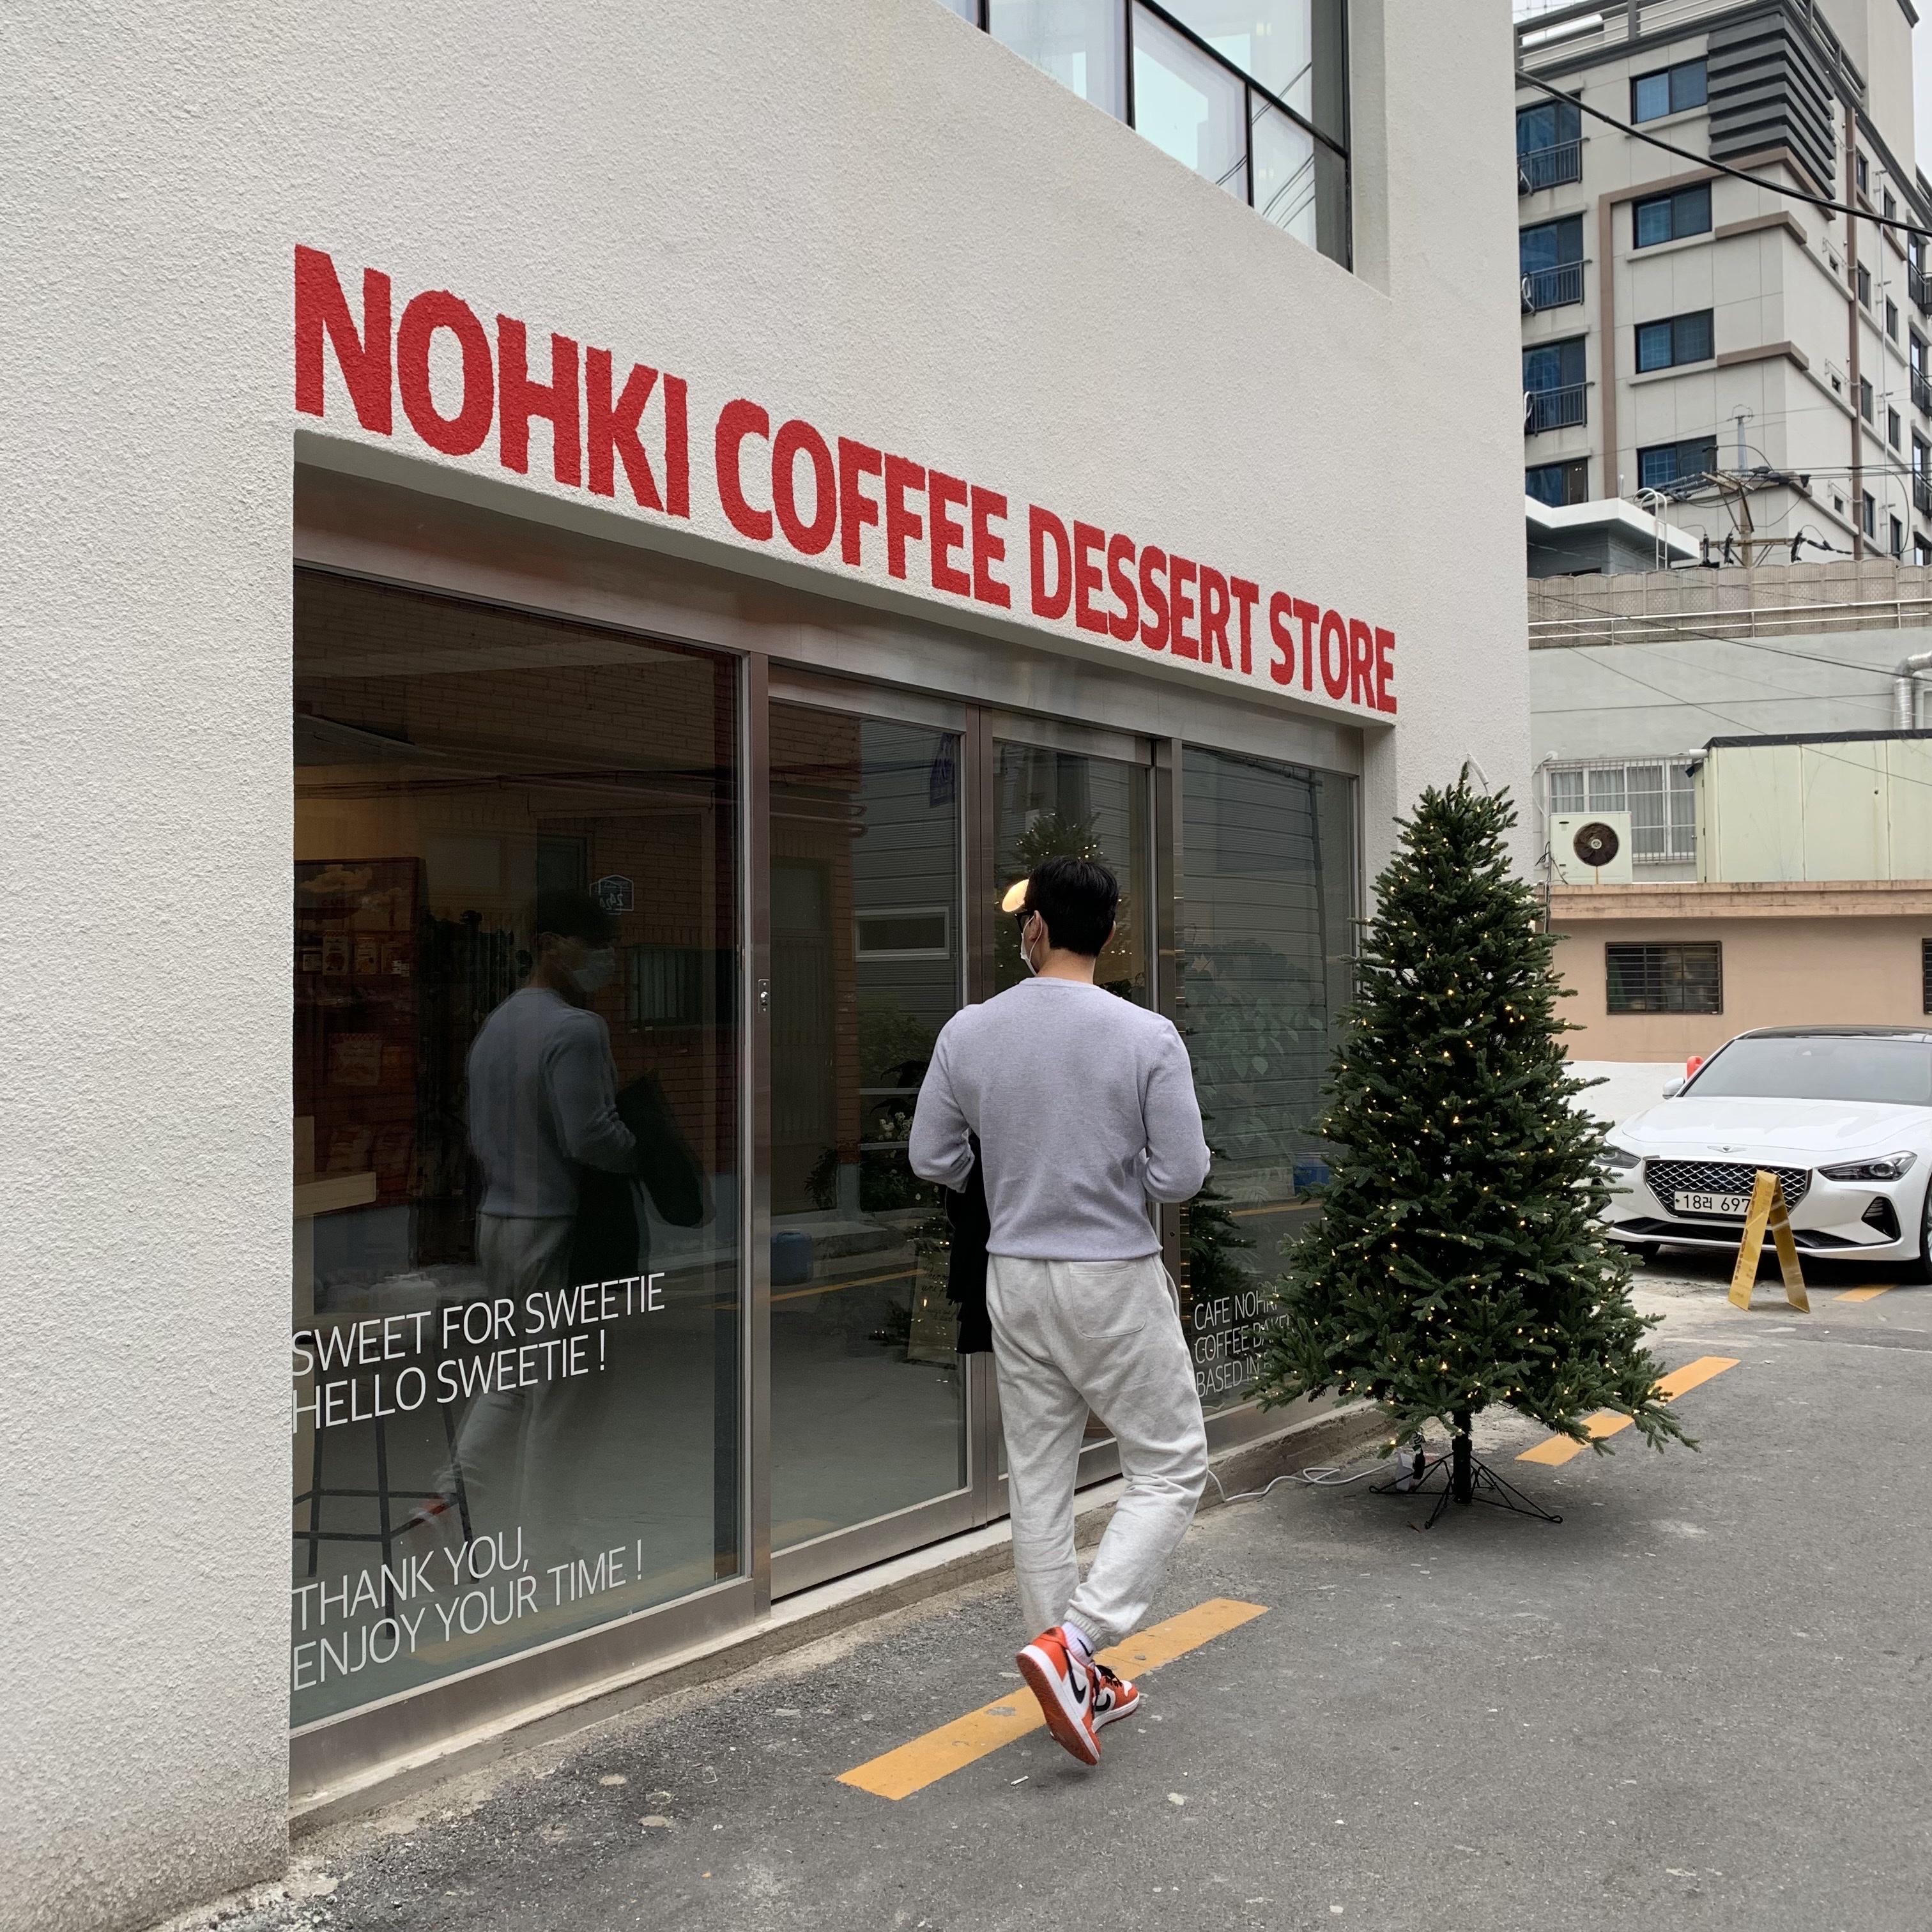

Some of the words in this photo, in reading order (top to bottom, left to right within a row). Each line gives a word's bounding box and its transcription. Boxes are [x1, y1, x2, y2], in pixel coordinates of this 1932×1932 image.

[295, 243, 690, 519] NOHKI
[715, 397, 1011, 610] COFFEE
[1029, 503, 1259, 675] DESSERT
[1269, 591, 1397, 714] STORE
[1683, 1194, 1712, 1209] 18러
[1721, 1197, 1751, 1213] 697
[292, 1311, 431, 1376] SWEET
[443, 1299, 515, 1349] FOR
[525, 1272, 665, 1334] SWEETIE
[1194, 1296, 1230, 1331] CAFE
[1195, 1324, 1250, 1364] COFFEE
[292, 1367, 426, 1434] HELLO
[1196, 1360, 1243, 1399] BASED
[1246, 1356, 1259, 1374] IN
[291, 1551, 434, 1631] THANK
[443, 1526, 530, 1586] YOU,
[293, 1607, 426, 1692] ENJOY
[435, 1575, 539, 1642] YOUR
